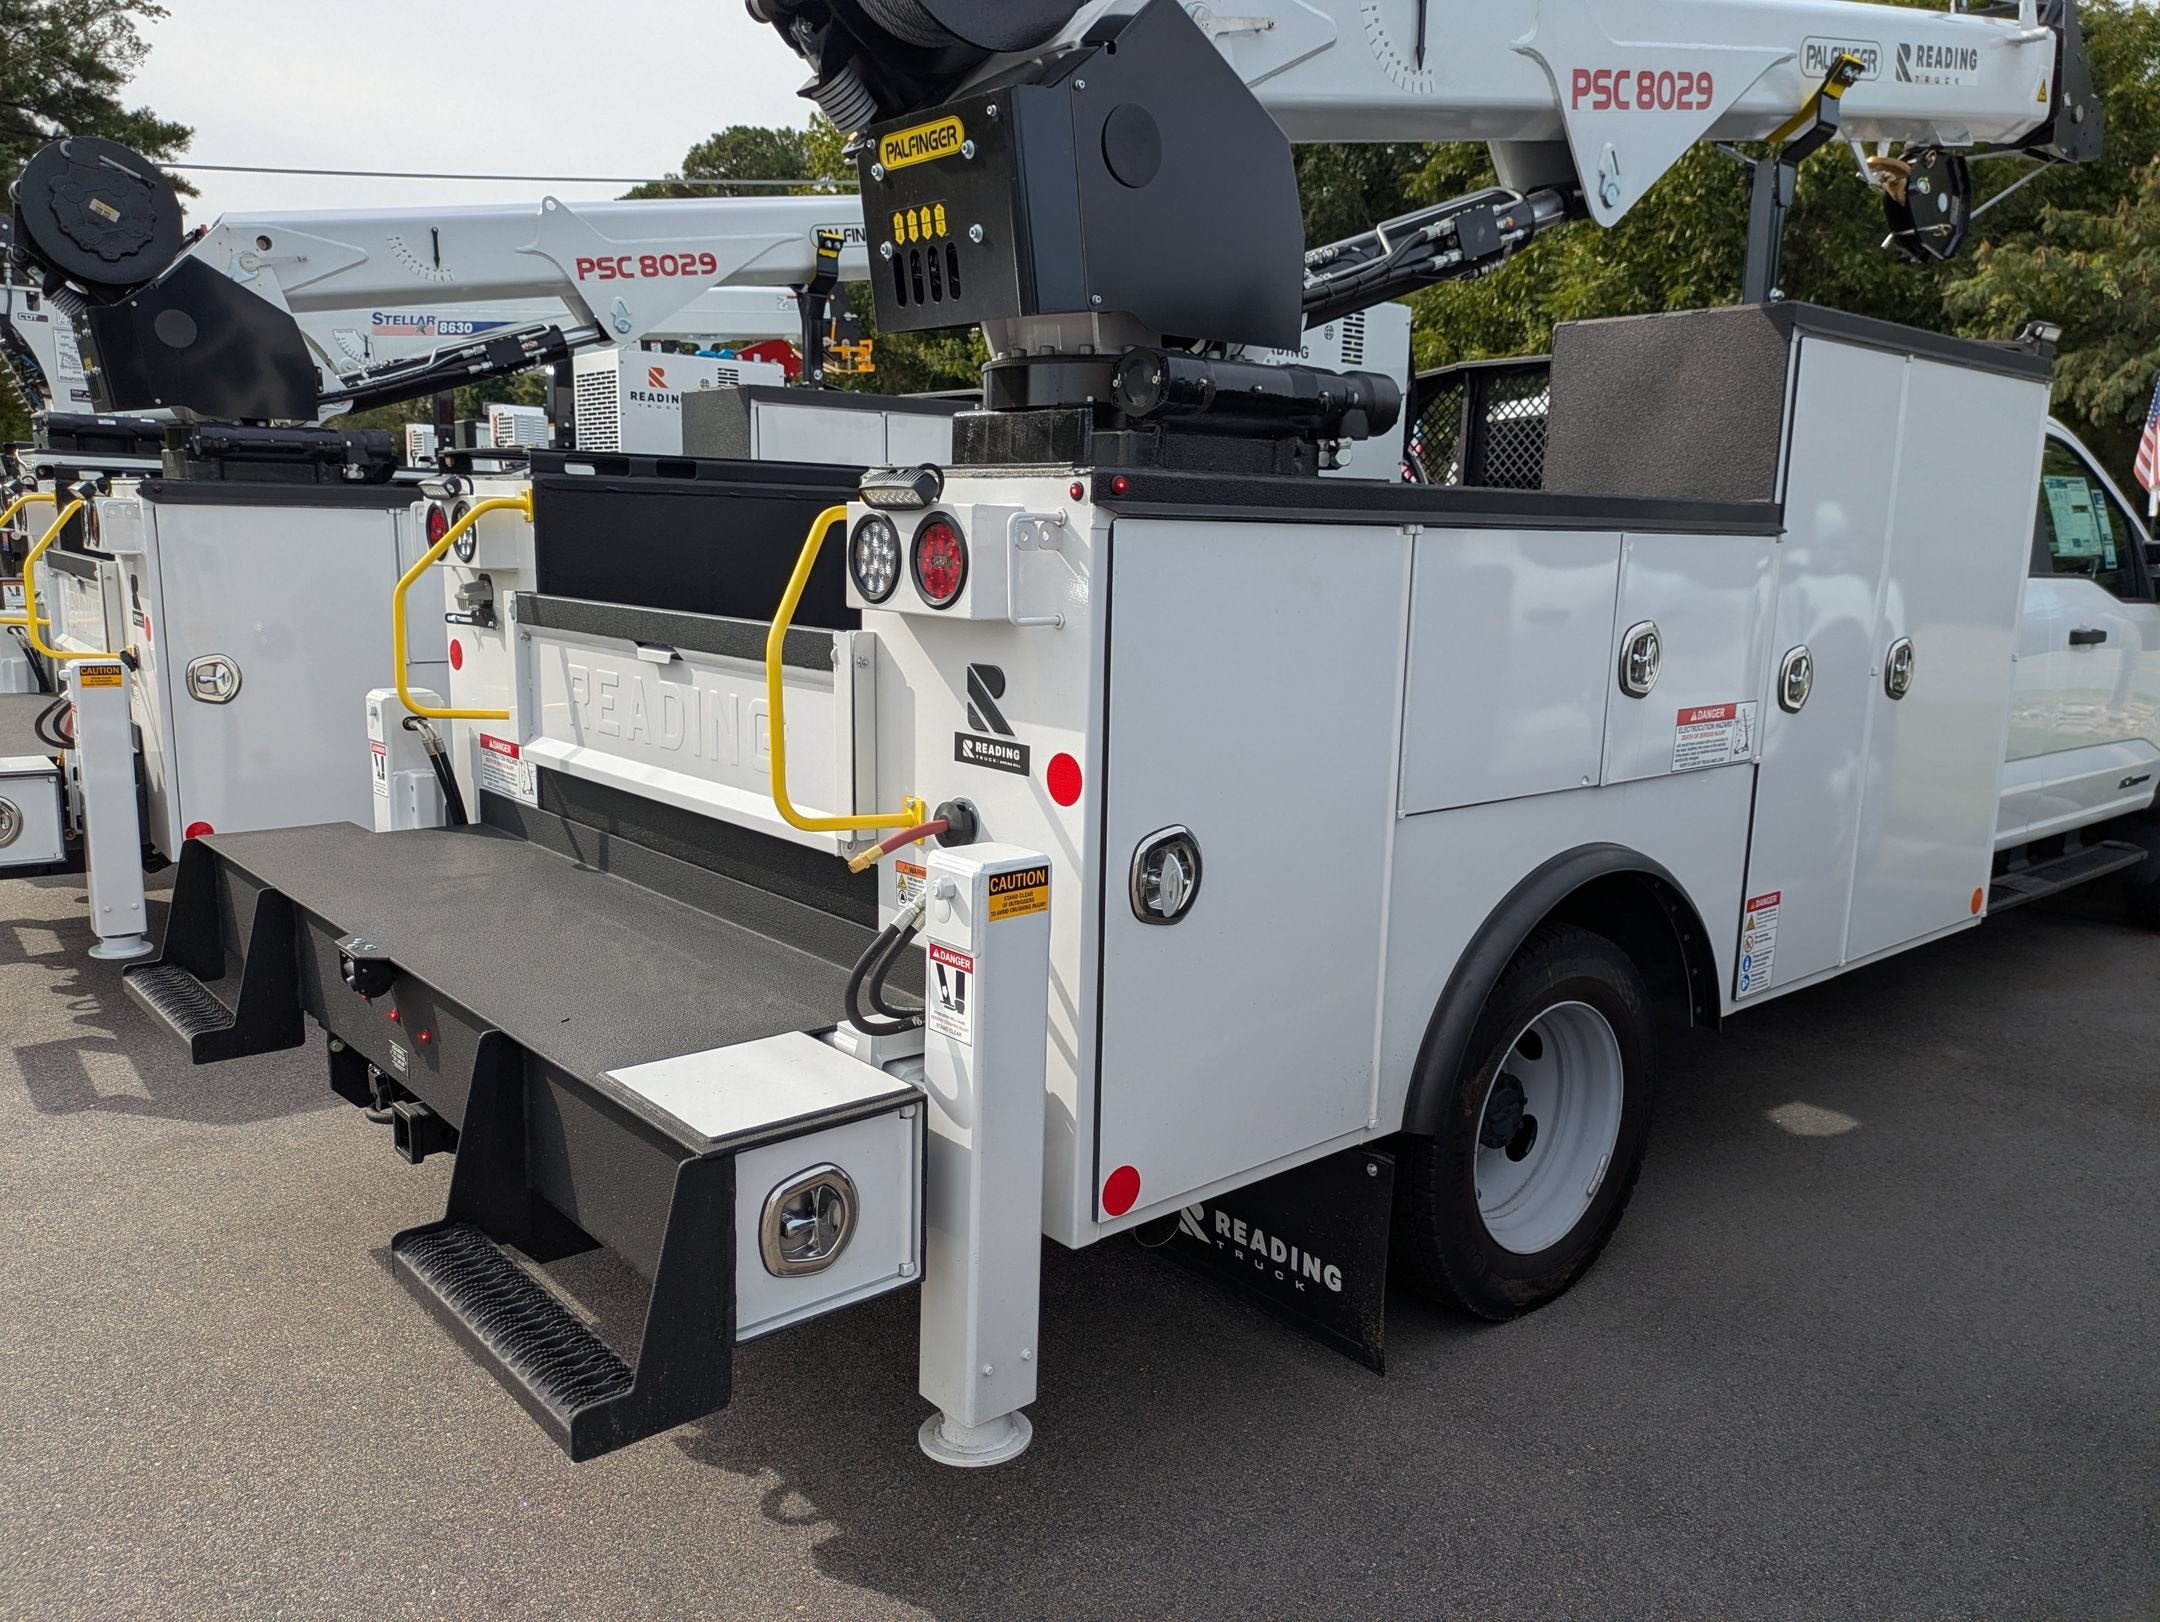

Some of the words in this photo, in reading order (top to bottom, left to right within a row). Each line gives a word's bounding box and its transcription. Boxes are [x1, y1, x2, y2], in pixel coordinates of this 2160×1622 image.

[1915, 45, 1978, 71] READING
[1572, 68, 1630, 110] PSC
[1636, 70, 1713, 111] 8029
[885, 124, 958, 164] PALFINGER
[576, 256, 635, 281] PSC
[638, 252, 717, 278] 8029
[371, 312, 436, 326] STELLAR
[439, 322, 473, 334] 8630
[80, 667, 119, 675] CAUTION
[1697, 708, 1726, 720] DANGER
[975, 741, 1020, 761] READING
[990, 869, 1045, 893] CAUTION
[940, 951, 971, 970] DANGER
[1215, 1209, 1342, 1292] READING
[1216, 1240, 1305, 1291] TRUCK
